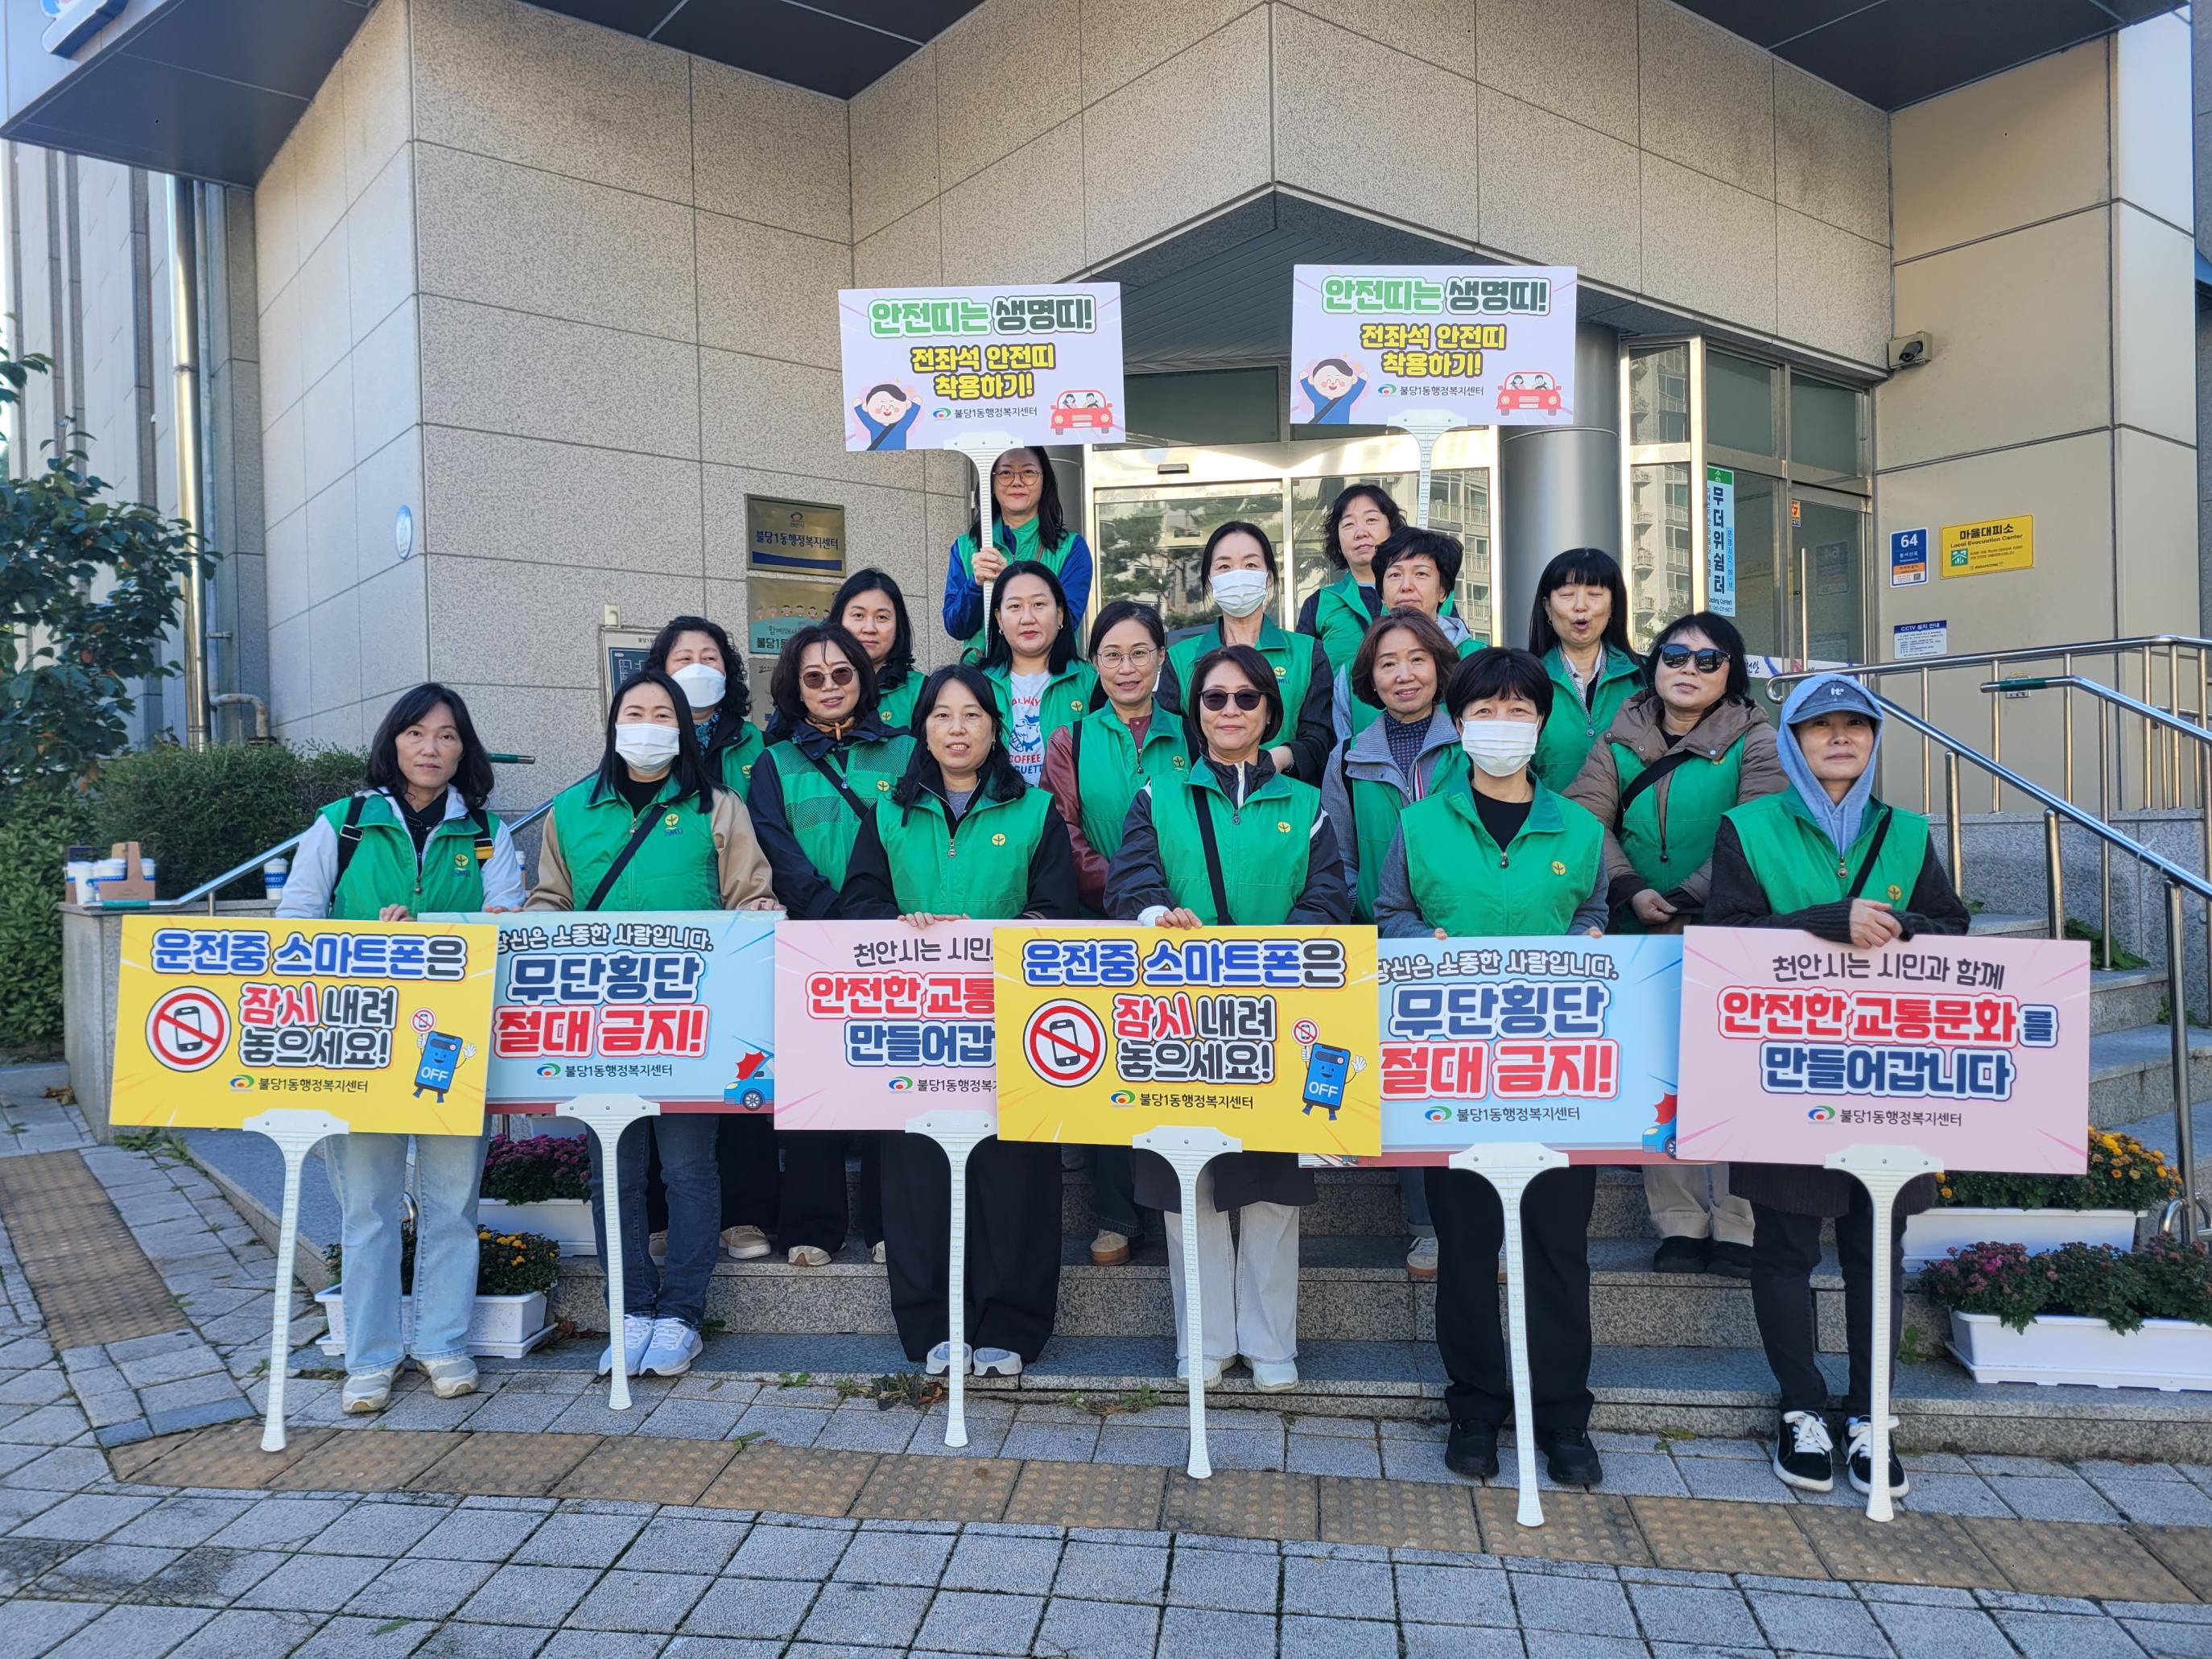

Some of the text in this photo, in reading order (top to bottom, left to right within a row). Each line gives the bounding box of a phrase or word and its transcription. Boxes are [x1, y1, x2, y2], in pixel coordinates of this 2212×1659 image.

[1324, 278, 1548, 313] 안전띠는 생명띠!
[870, 297, 1093, 335] 안전띠는 생명띠!
[1360, 324, 1506, 349] 전좌석 안전띠
[910, 343, 1055, 372] 전좌석 안전띠
[1382, 351, 1483, 377] 착용하기!
[934, 373, 1034, 399] 착용하기!
[1399, 385, 1484, 397] 불당1동행정복지센터
[954, 406, 1038, 419] 불당1동행정복지센터
[755, 530, 838, 551] 불당1동행정복지센터
[1713, 486, 1724, 594] 무더위쉼터
[1900, 534, 1918, 548] 64
[1959, 523, 2014, 540] 마을대피소
[1967, 538, 2001, 546] Evacuation
[552, 925, 609, 947] 소중한
[614, 924, 714, 951] 사람입니다.
[853, 937, 993, 967] 천안시는 시민
[152, 931, 465, 980] 운전중 스마트폰은
[1024, 941, 1344, 987] 운전중 스마트폰은
[1438, 950, 1501, 976] 소중한
[1507, 950, 1619, 980] 사람입니다.
[510, 954, 703, 1003] 무단횡단
[1772, 952, 2005, 990] 천안시는 시민과 함께
[241, 984, 397, 1027] 잠시 내려
[809, 975, 923, 1015] 안전한
[1392, 981, 1607, 1038] 무단횡단
[496, 1008, 707, 1055] 절대 금지!
[1114, 995, 1277, 1041] 잠시 내려
[1722, 992, 2057, 1045] 안전한 교통문화를
[241, 1027, 391, 1068] 놓으세요!
[1117, 1042, 1274, 1083] 놓으세요!
[420, 1065, 450, 1083] OFF
[565, 1063, 673, 1078] 불당1동행정복지센터
[1380, 1042, 1616, 1096] 절대 금지!
[1764, 1046, 2012, 1097] 만들어갑니다
[258, 1077, 369, 1093] 불당1동행정복지센터
[1308, 1080, 1339, 1098] OFF
[1139, 1092, 1254, 1110] 불당1동행정복지센터
[1456, 1106, 1581, 1122] 불당1동행정복지센터
[1839, 1109, 1962, 1128] 불당1동행정복지센터
